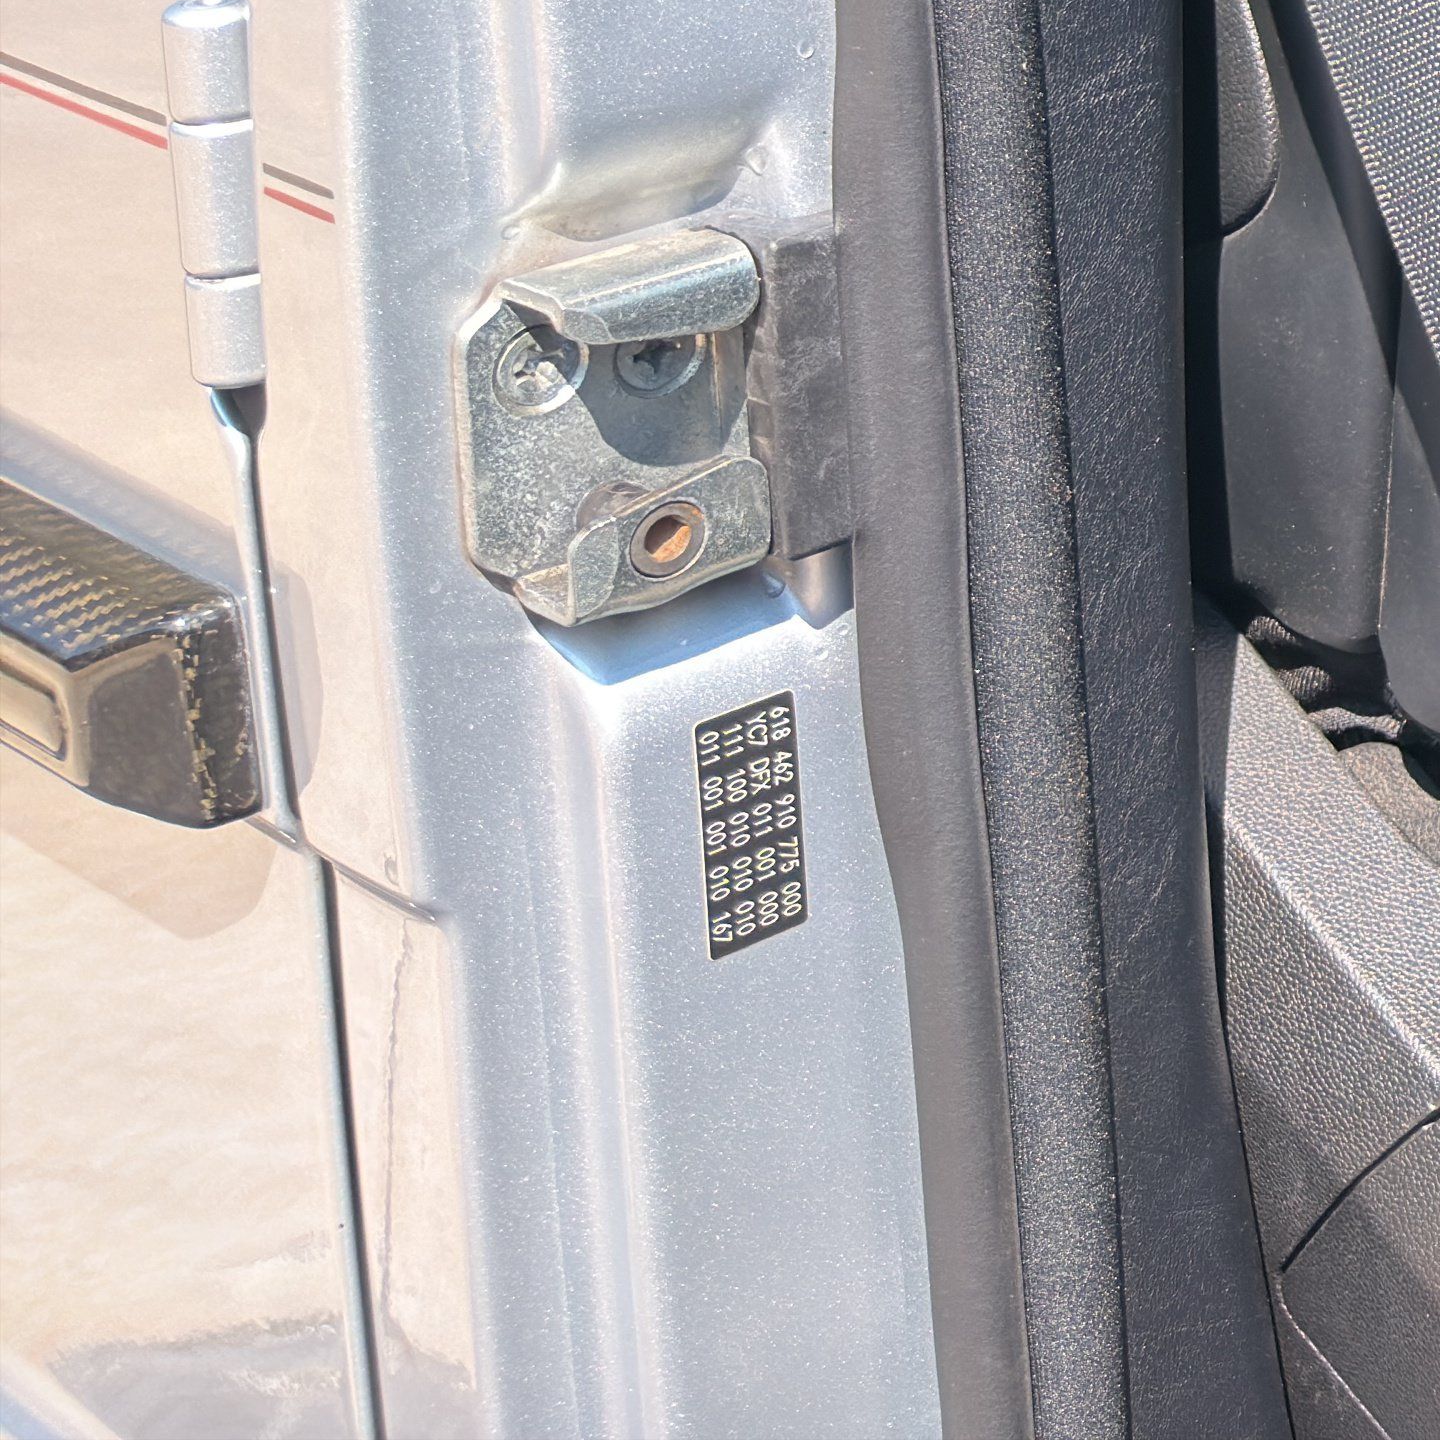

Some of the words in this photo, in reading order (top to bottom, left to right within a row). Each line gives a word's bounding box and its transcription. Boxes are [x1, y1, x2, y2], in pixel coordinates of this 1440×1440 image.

[722, 724, 744, 757] 111
[746, 711, 768, 746] YC7
[769, 706, 790, 740] 618
[699, 731, 719, 766] 011
[726, 769, 747, 802] 100
[750, 758, 770, 795] DFX
[773, 750, 793, 786] 462
[703, 776, 724, 811] 001
[752, 802, 772, 837] 011
[775, 794, 796, 829] 910
[706, 821, 727, 856] 001
[730, 812, 749, 847] 010
[756, 847, 775, 880] 001
[779, 836, 800, 872] 775
[710, 866, 730, 901] 010
[733, 856, 753, 891] 010
[759, 891, 778, 926] 000
[782, 881, 802, 916] 000
[712, 912, 732, 942] 167
[736, 901, 756, 936] 010
